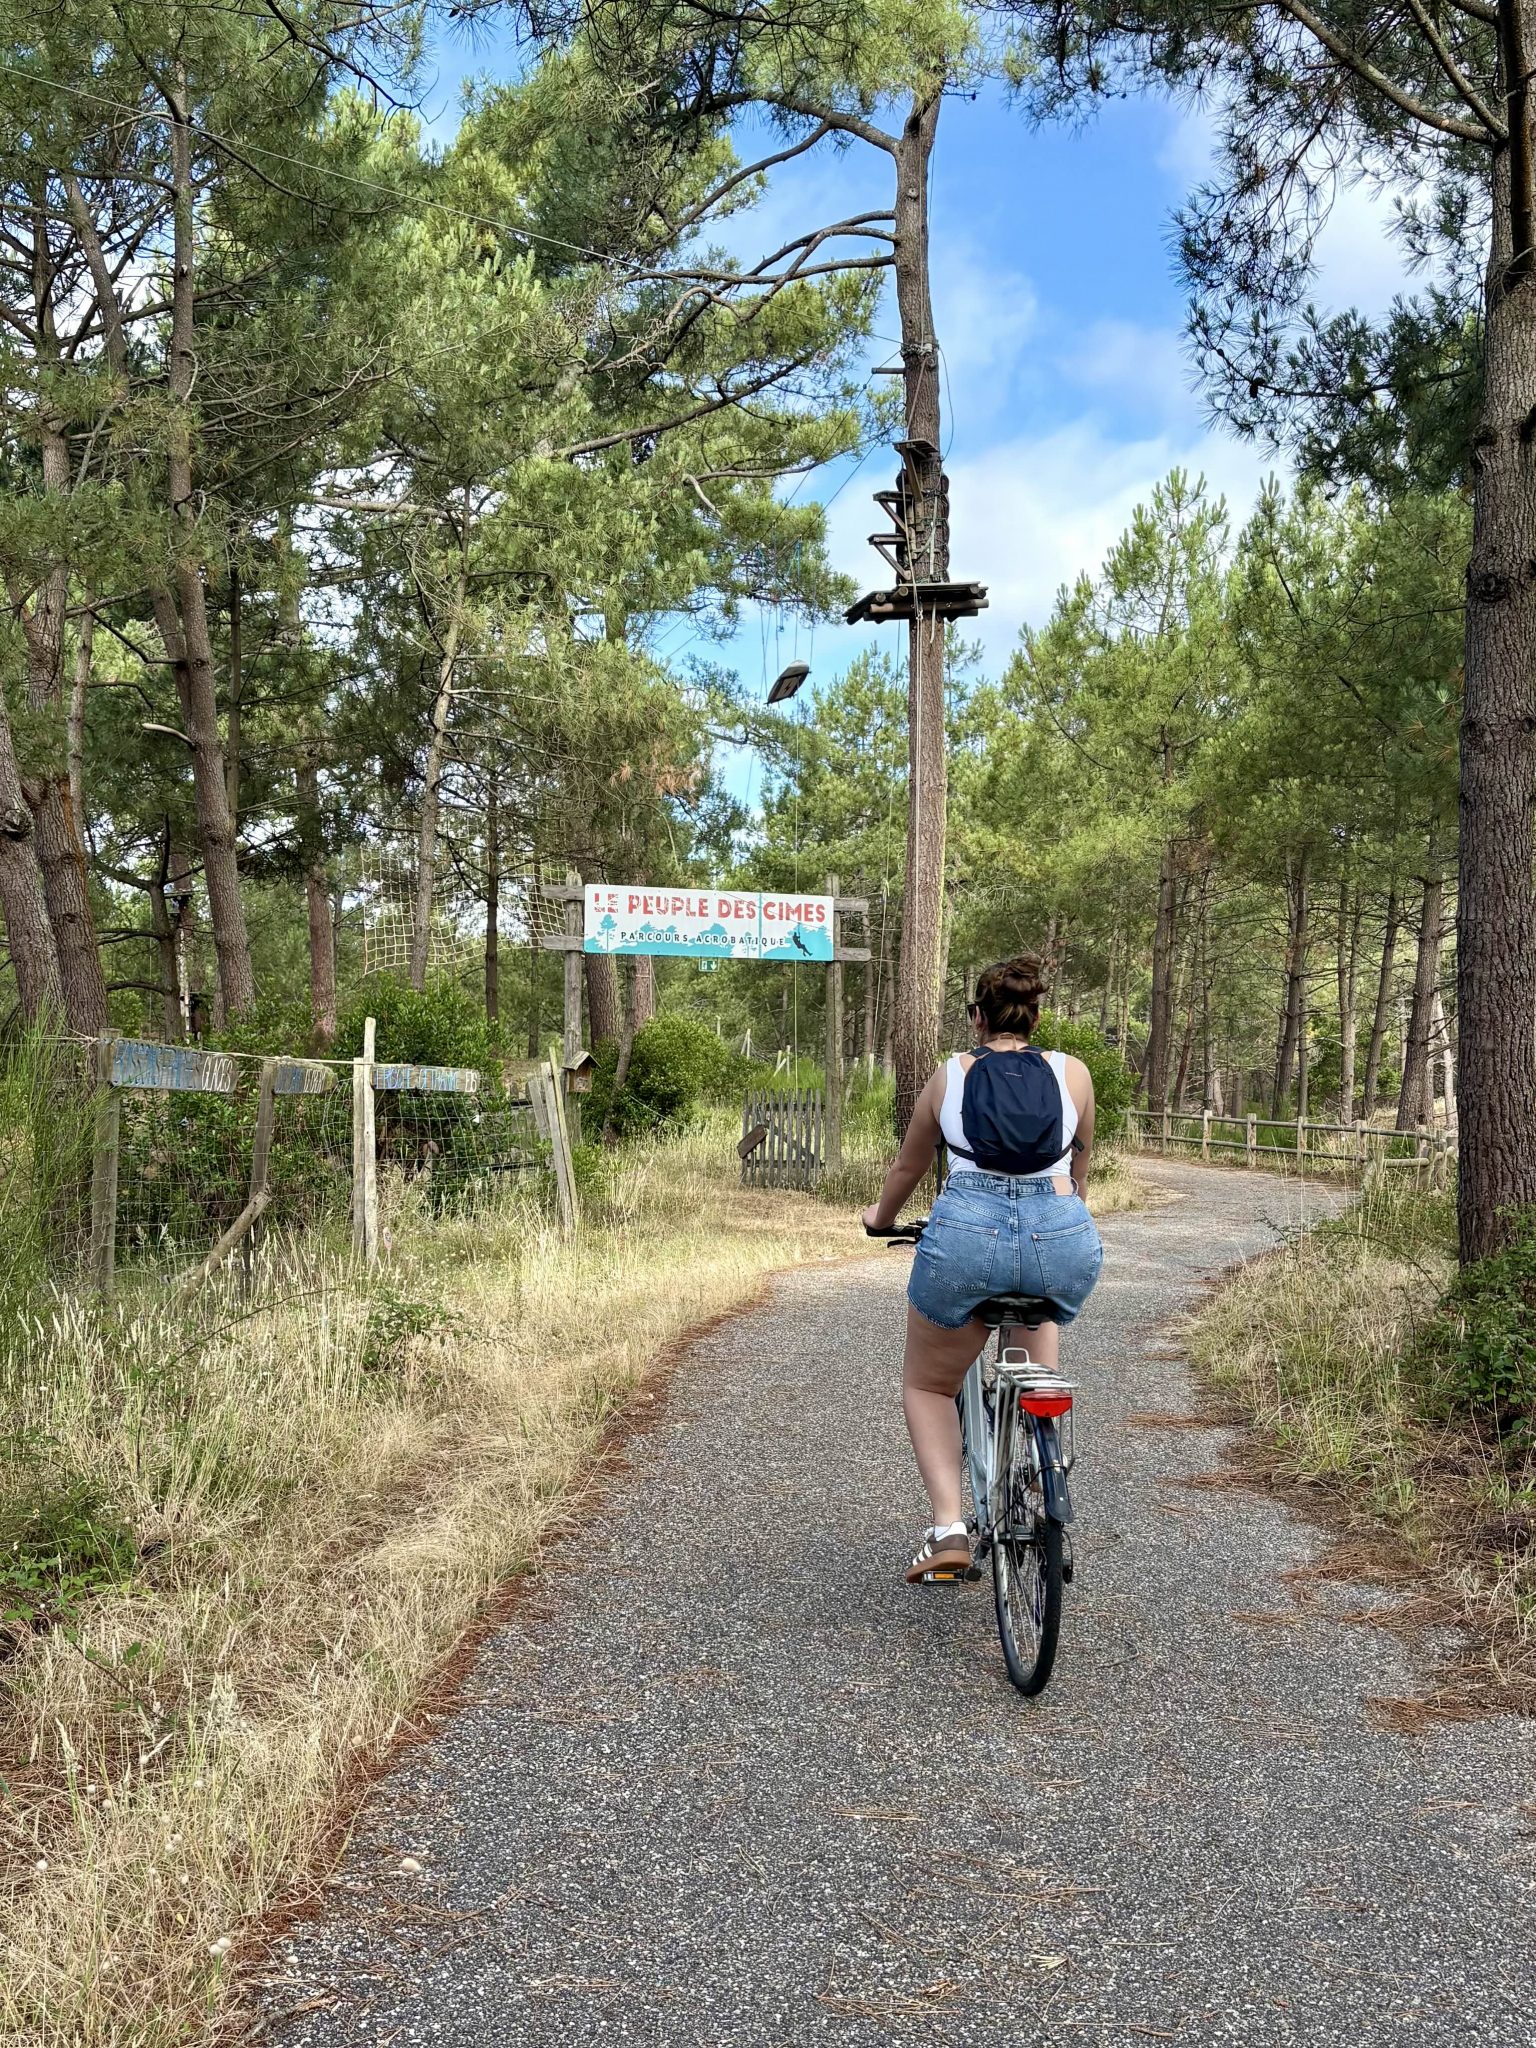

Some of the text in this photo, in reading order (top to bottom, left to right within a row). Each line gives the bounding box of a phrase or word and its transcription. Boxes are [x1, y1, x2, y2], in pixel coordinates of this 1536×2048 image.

[594, 892, 826, 923] LE PEUPLE DES CIMES
[620, 931, 784, 947] PARCOURS ACROBATIQUE
[201, 1055, 233, 1092] GLACES
